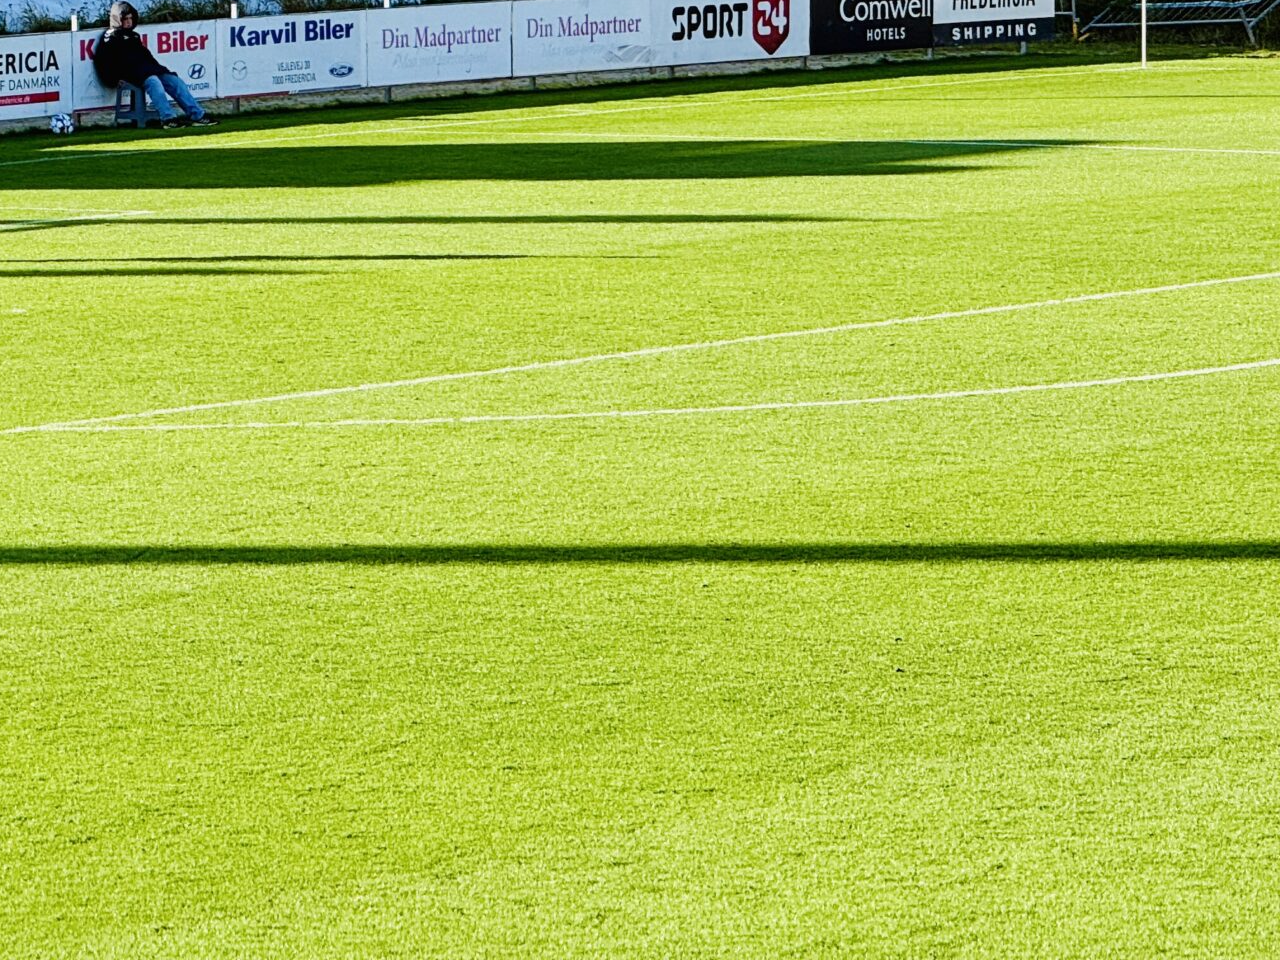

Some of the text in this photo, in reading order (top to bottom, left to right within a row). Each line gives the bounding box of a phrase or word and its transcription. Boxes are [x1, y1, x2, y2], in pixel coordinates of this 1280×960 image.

[526, 14, 642, 42] Din Madpartner
[672, 1, 787, 41] SPORT 24
[952, 22, 1037, 41] SHIPPING
[157, 30, 209, 54] Biler
[230, 19, 354, 48] Karvil Biler
[382, 24, 501, 53] Din Madpartner
[866, 26, 906, 41] HOTELS
[8, 76, 60, 91] DANMARK
[285, 73, 317, 84] FREDERICIA
